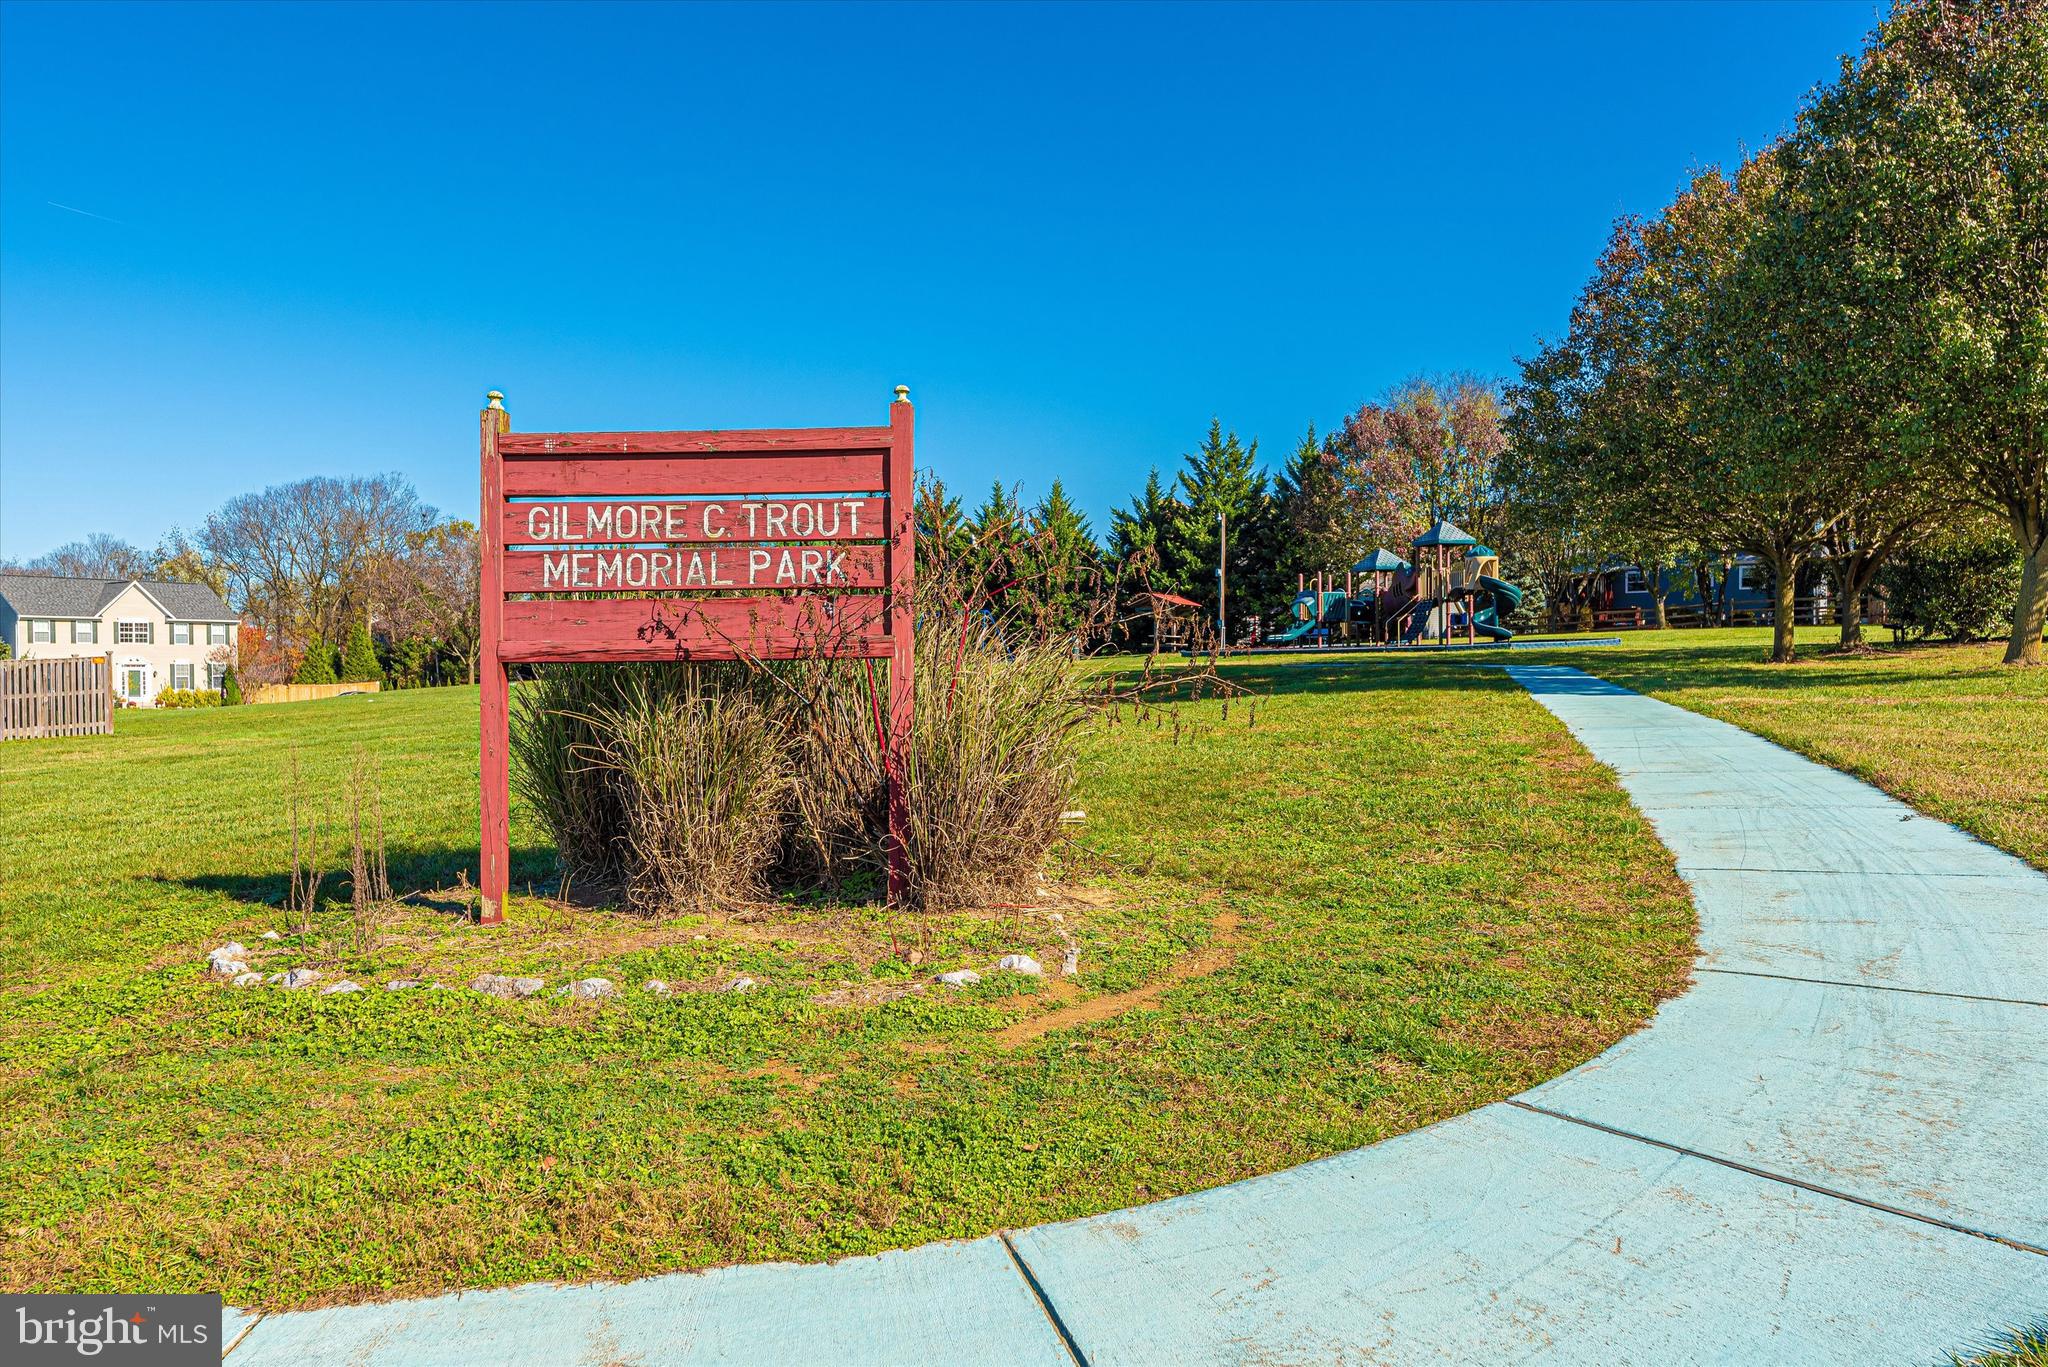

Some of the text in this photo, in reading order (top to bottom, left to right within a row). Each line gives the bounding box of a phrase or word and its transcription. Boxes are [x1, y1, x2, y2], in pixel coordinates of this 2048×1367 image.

[528, 505, 688, 540] GILMORE
[742, 501, 865, 537] TROUT
[543, 550, 847, 588] MEMORIAL PARK
